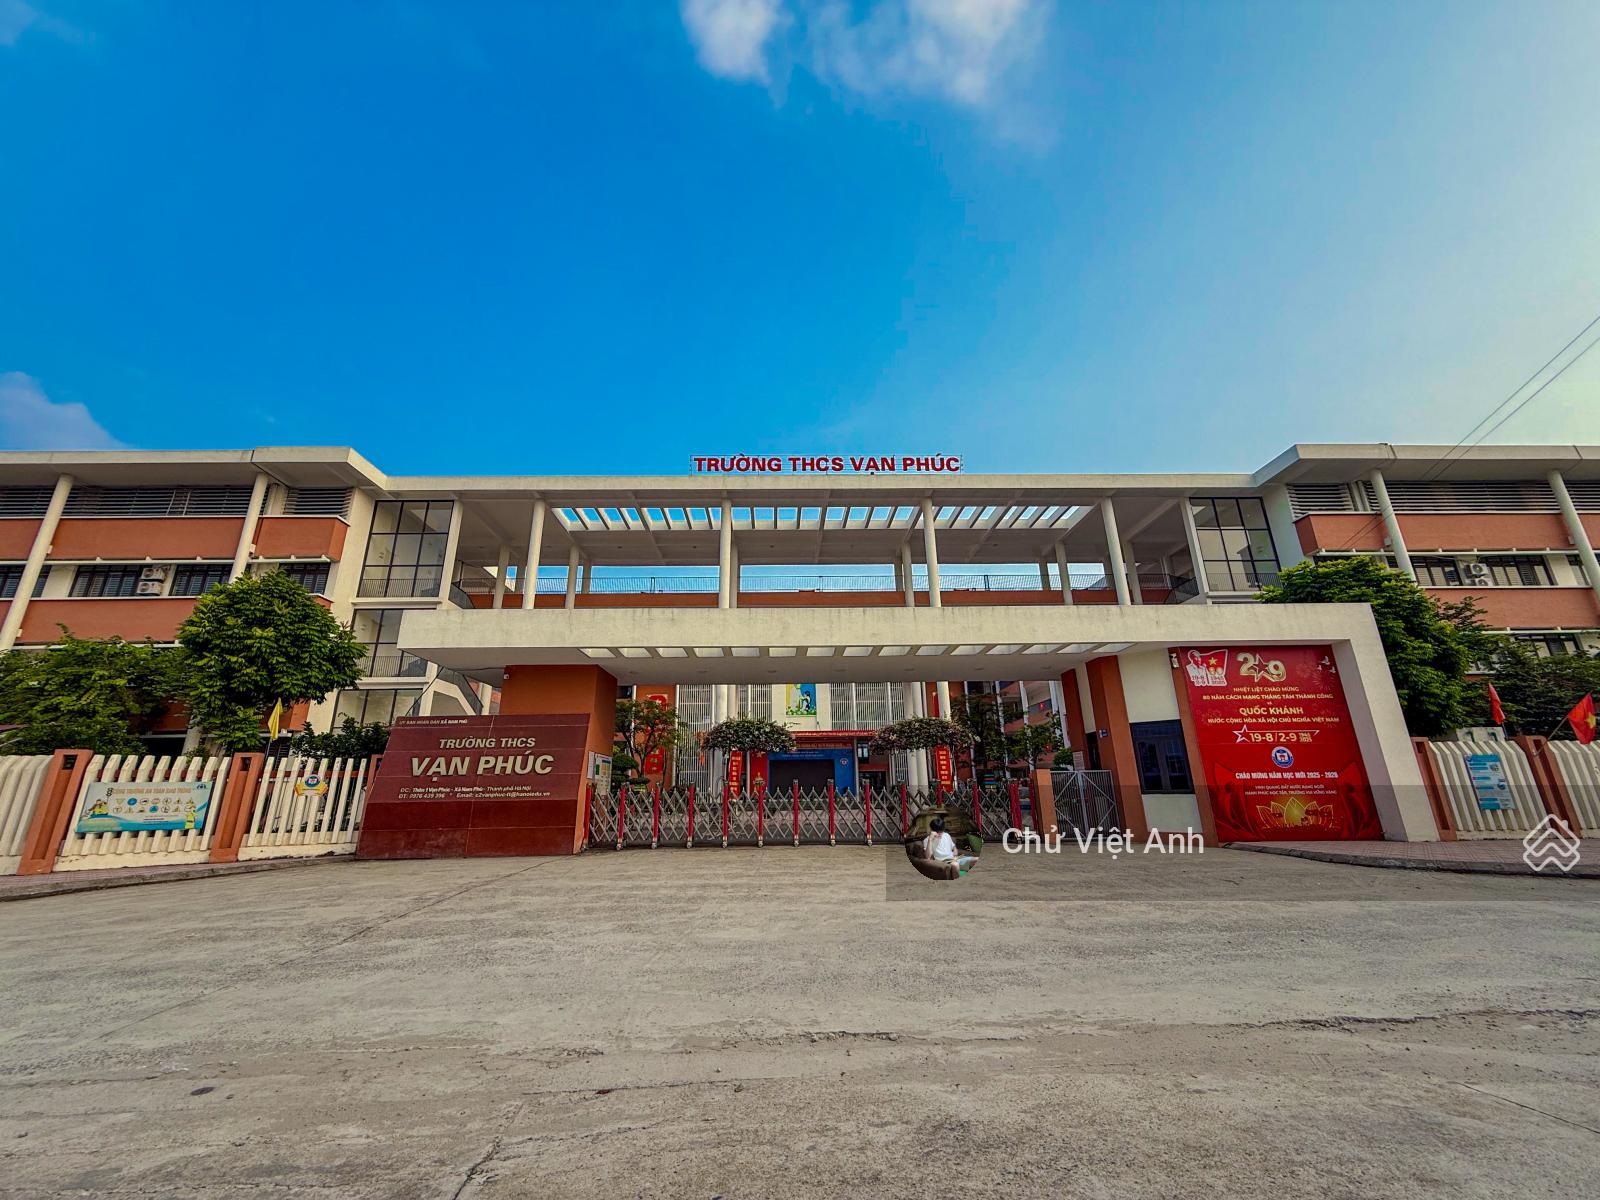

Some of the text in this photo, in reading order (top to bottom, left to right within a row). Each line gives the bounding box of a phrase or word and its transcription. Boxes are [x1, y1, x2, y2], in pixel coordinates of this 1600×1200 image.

[694, 453, 960, 476] TRƯỜNG THCS VẠN PHÚC
[1239, 705, 1304, 716] QUỐC KHÁNH
[439, 735, 536, 749] TRƯỜNG THCS
[1249, 733, 1297, 742] 19-8 2-9
[411, 750, 554, 781] VẠN PHÚC
[1235, 771, 1250, 779] CHÀO
